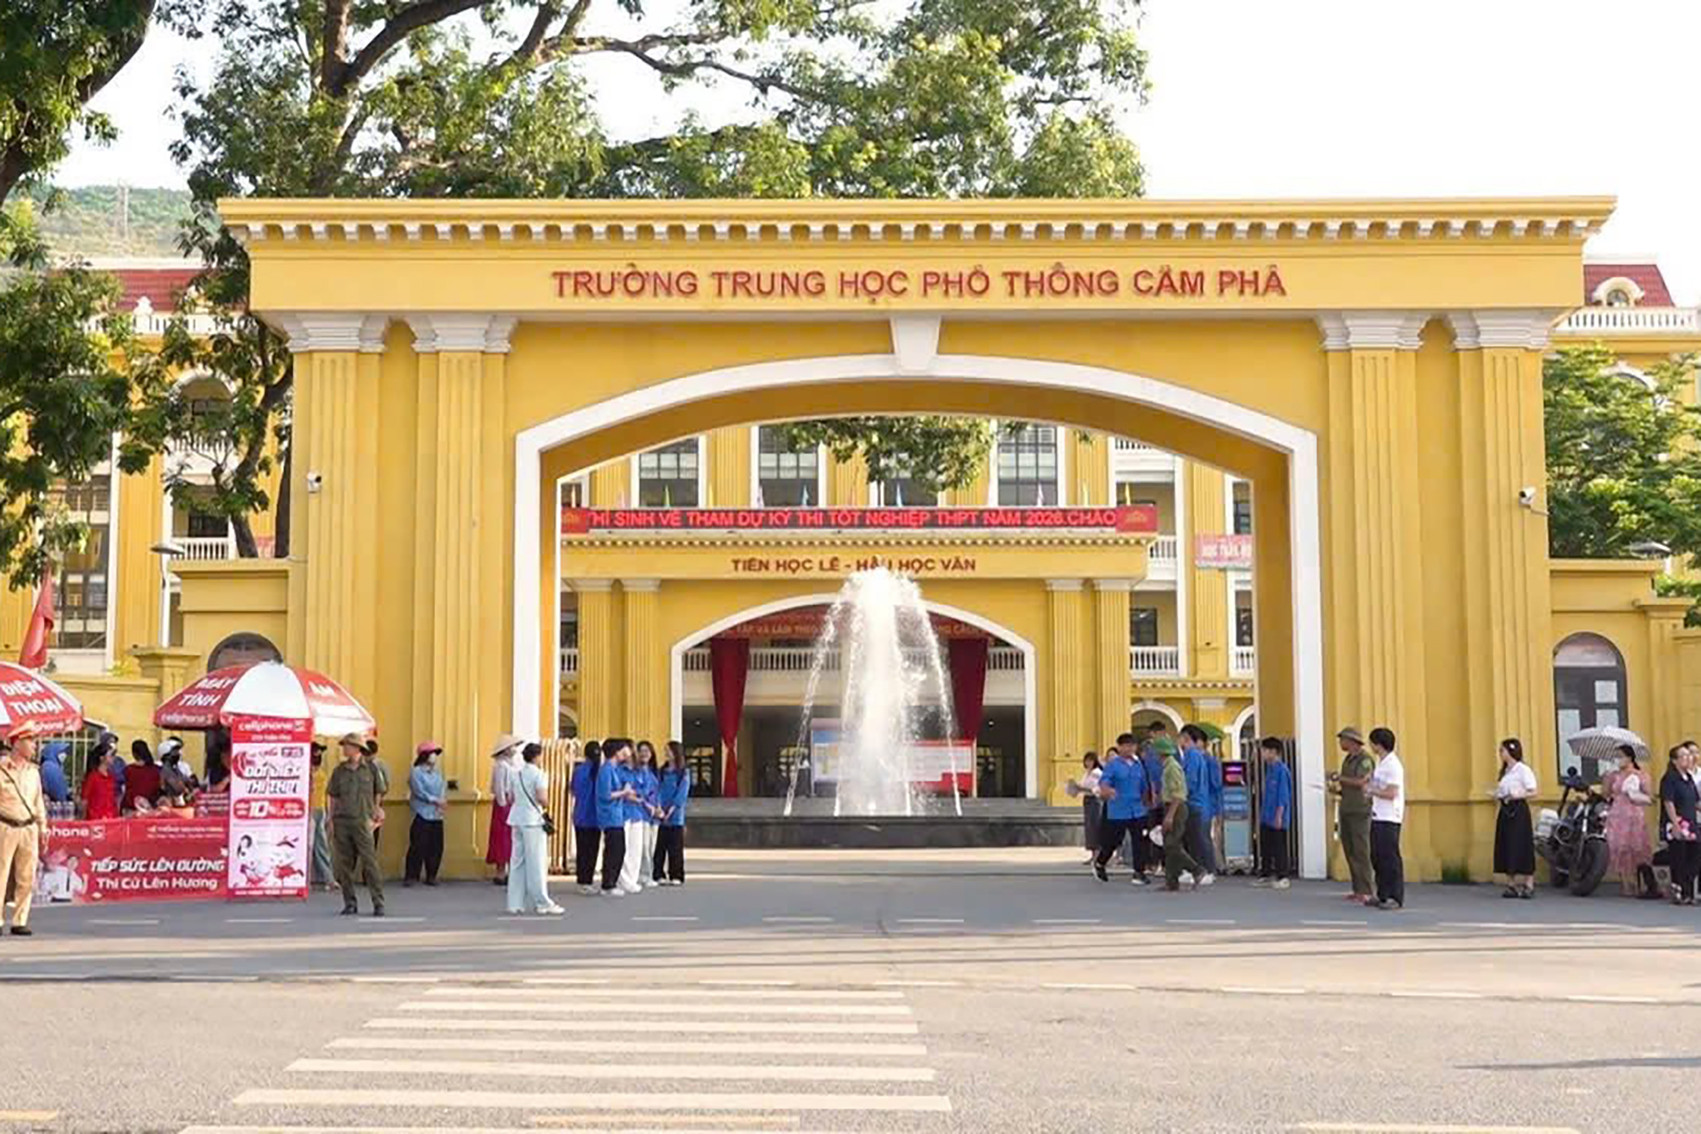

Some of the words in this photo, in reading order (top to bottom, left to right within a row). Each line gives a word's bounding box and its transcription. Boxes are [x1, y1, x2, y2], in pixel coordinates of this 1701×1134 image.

[552, 262, 698, 298] TRƯỜNG
[711, 271, 825, 298] TRUNG
[839, 270, 908, 304] HỌC
[1001, 262, 1119, 297] THÔNG
[614, 511, 655, 526] SINH
[686, 511, 734, 526] THAM
[798, 511, 824, 526] THI
[938, 511, 977, 526] THPT
[776, 559, 813, 574] HỌC
[898, 558, 936, 574] HỌC
[941, 556, 976, 571] VĂN
[96, 877, 119, 889] Thi
